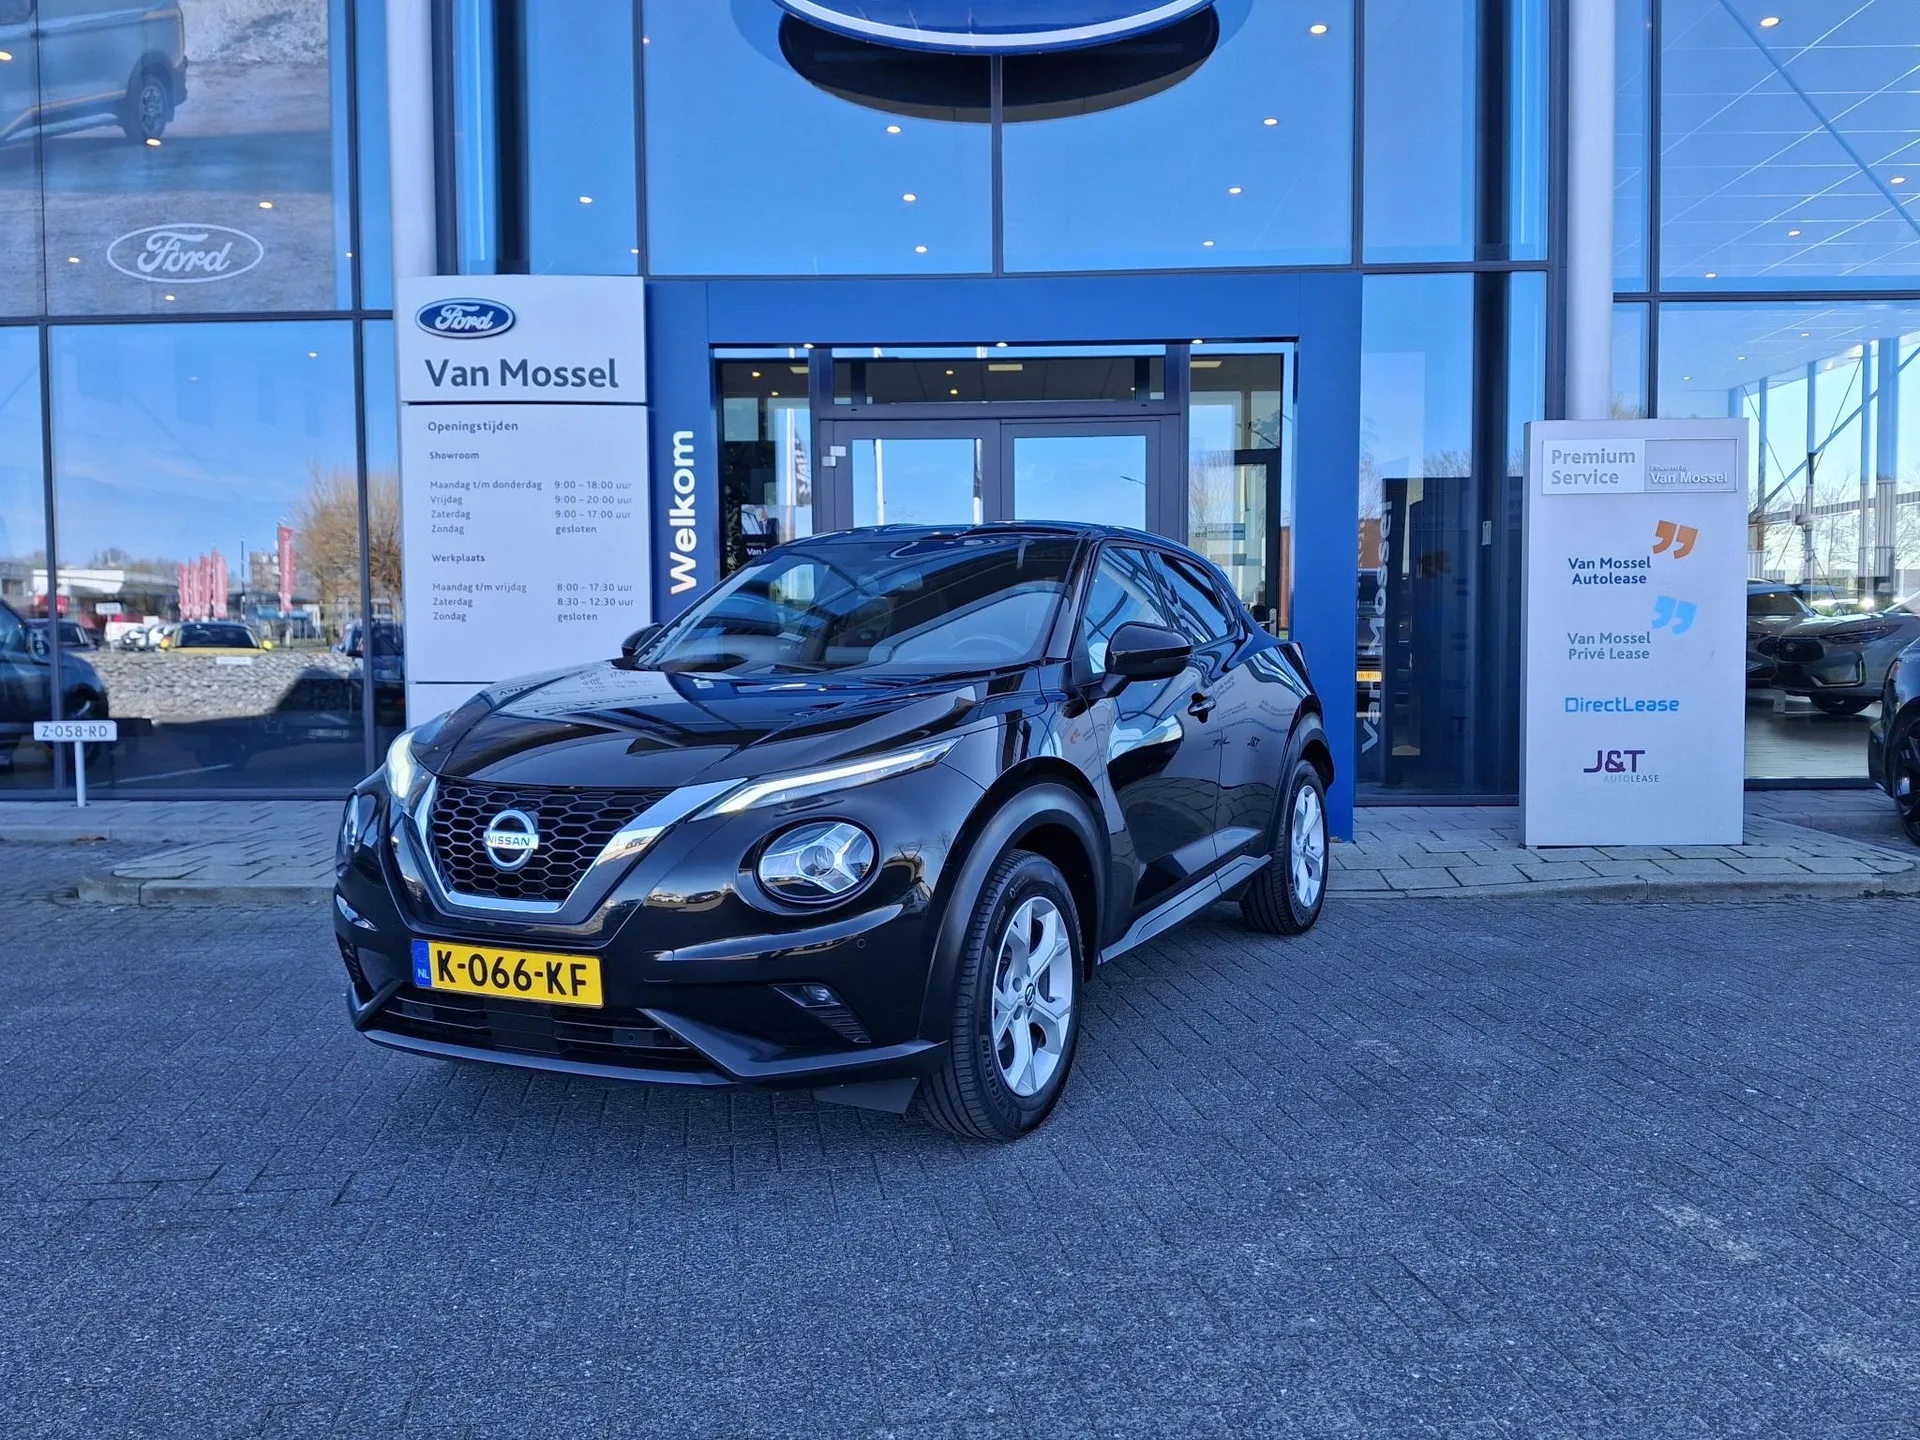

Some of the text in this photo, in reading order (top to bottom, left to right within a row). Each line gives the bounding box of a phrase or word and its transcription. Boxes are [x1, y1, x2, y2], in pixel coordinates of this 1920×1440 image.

[137, 231, 233, 272] Ford
[434, 304, 494, 331] Ford
[424, 358, 619, 388] Van Mossel
[428, 421, 519, 434] Openingstijden
[429, 451, 480, 460] Showroom
[1551, 448, 1636, 465] Premium
[1551, 469, 1619, 485] Service
[1650, 471, 1728, 483] Van Mossel
[430, 481, 471, 491] Maandag
[473, 481, 491, 489] t/m
[492, 481, 543, 491] donderdag
[554, 481, 576, 489] 9:00
[587, 481, 613, 489] 18:00
[430, 495, 463, 506] Vrijdag
[555, 496, 577, 504] 9:00
[587, 496, 614, 504] 20:00
[431, 510, 471, 520] Zaterdag
[555, 510, 577, 519] 9:00
[587, 511, 613, 519] 17:00
[669, 430, 697, 595] Welkom
[431, 525, 597, 535] Zondag gesloten
[432, 554, 485, 564] Werkplaats
[1568, 556, 1651, 569] Van Mossel
[1572, 572, 1647, 585] Autolease
[432, 583, 473, 593] Maandag
[475, 583, 493, 592] t/m
[495, 583, 527, 593] vrijdag
[557, 583, 579, 592] 8:00
[589, 583, 615, 592] 17:30
[432, 597, 473, 608] Zaterdag
[557, 598, 579, 606] 8:30
[589, 598, 616, 606] 12:30
[433, 612, 598, 622] Zondag gesloten
[1567, 631, 1651, 645] Van Mossel
[1568, 647, 1650, 660] Privé Lease
[1565, 697, 1680, 713] DirectLease
[42, 725, 108, 737] Z-058-RD
[1583, 750, 1646, 773] J&T
[1603, 775, 1659, 783] AUTOLEASE
[487, 835, 531, 847] NISSAN
[417, 968, 430, 979] NL
[436, 950, 587, 996] K-066-KF
